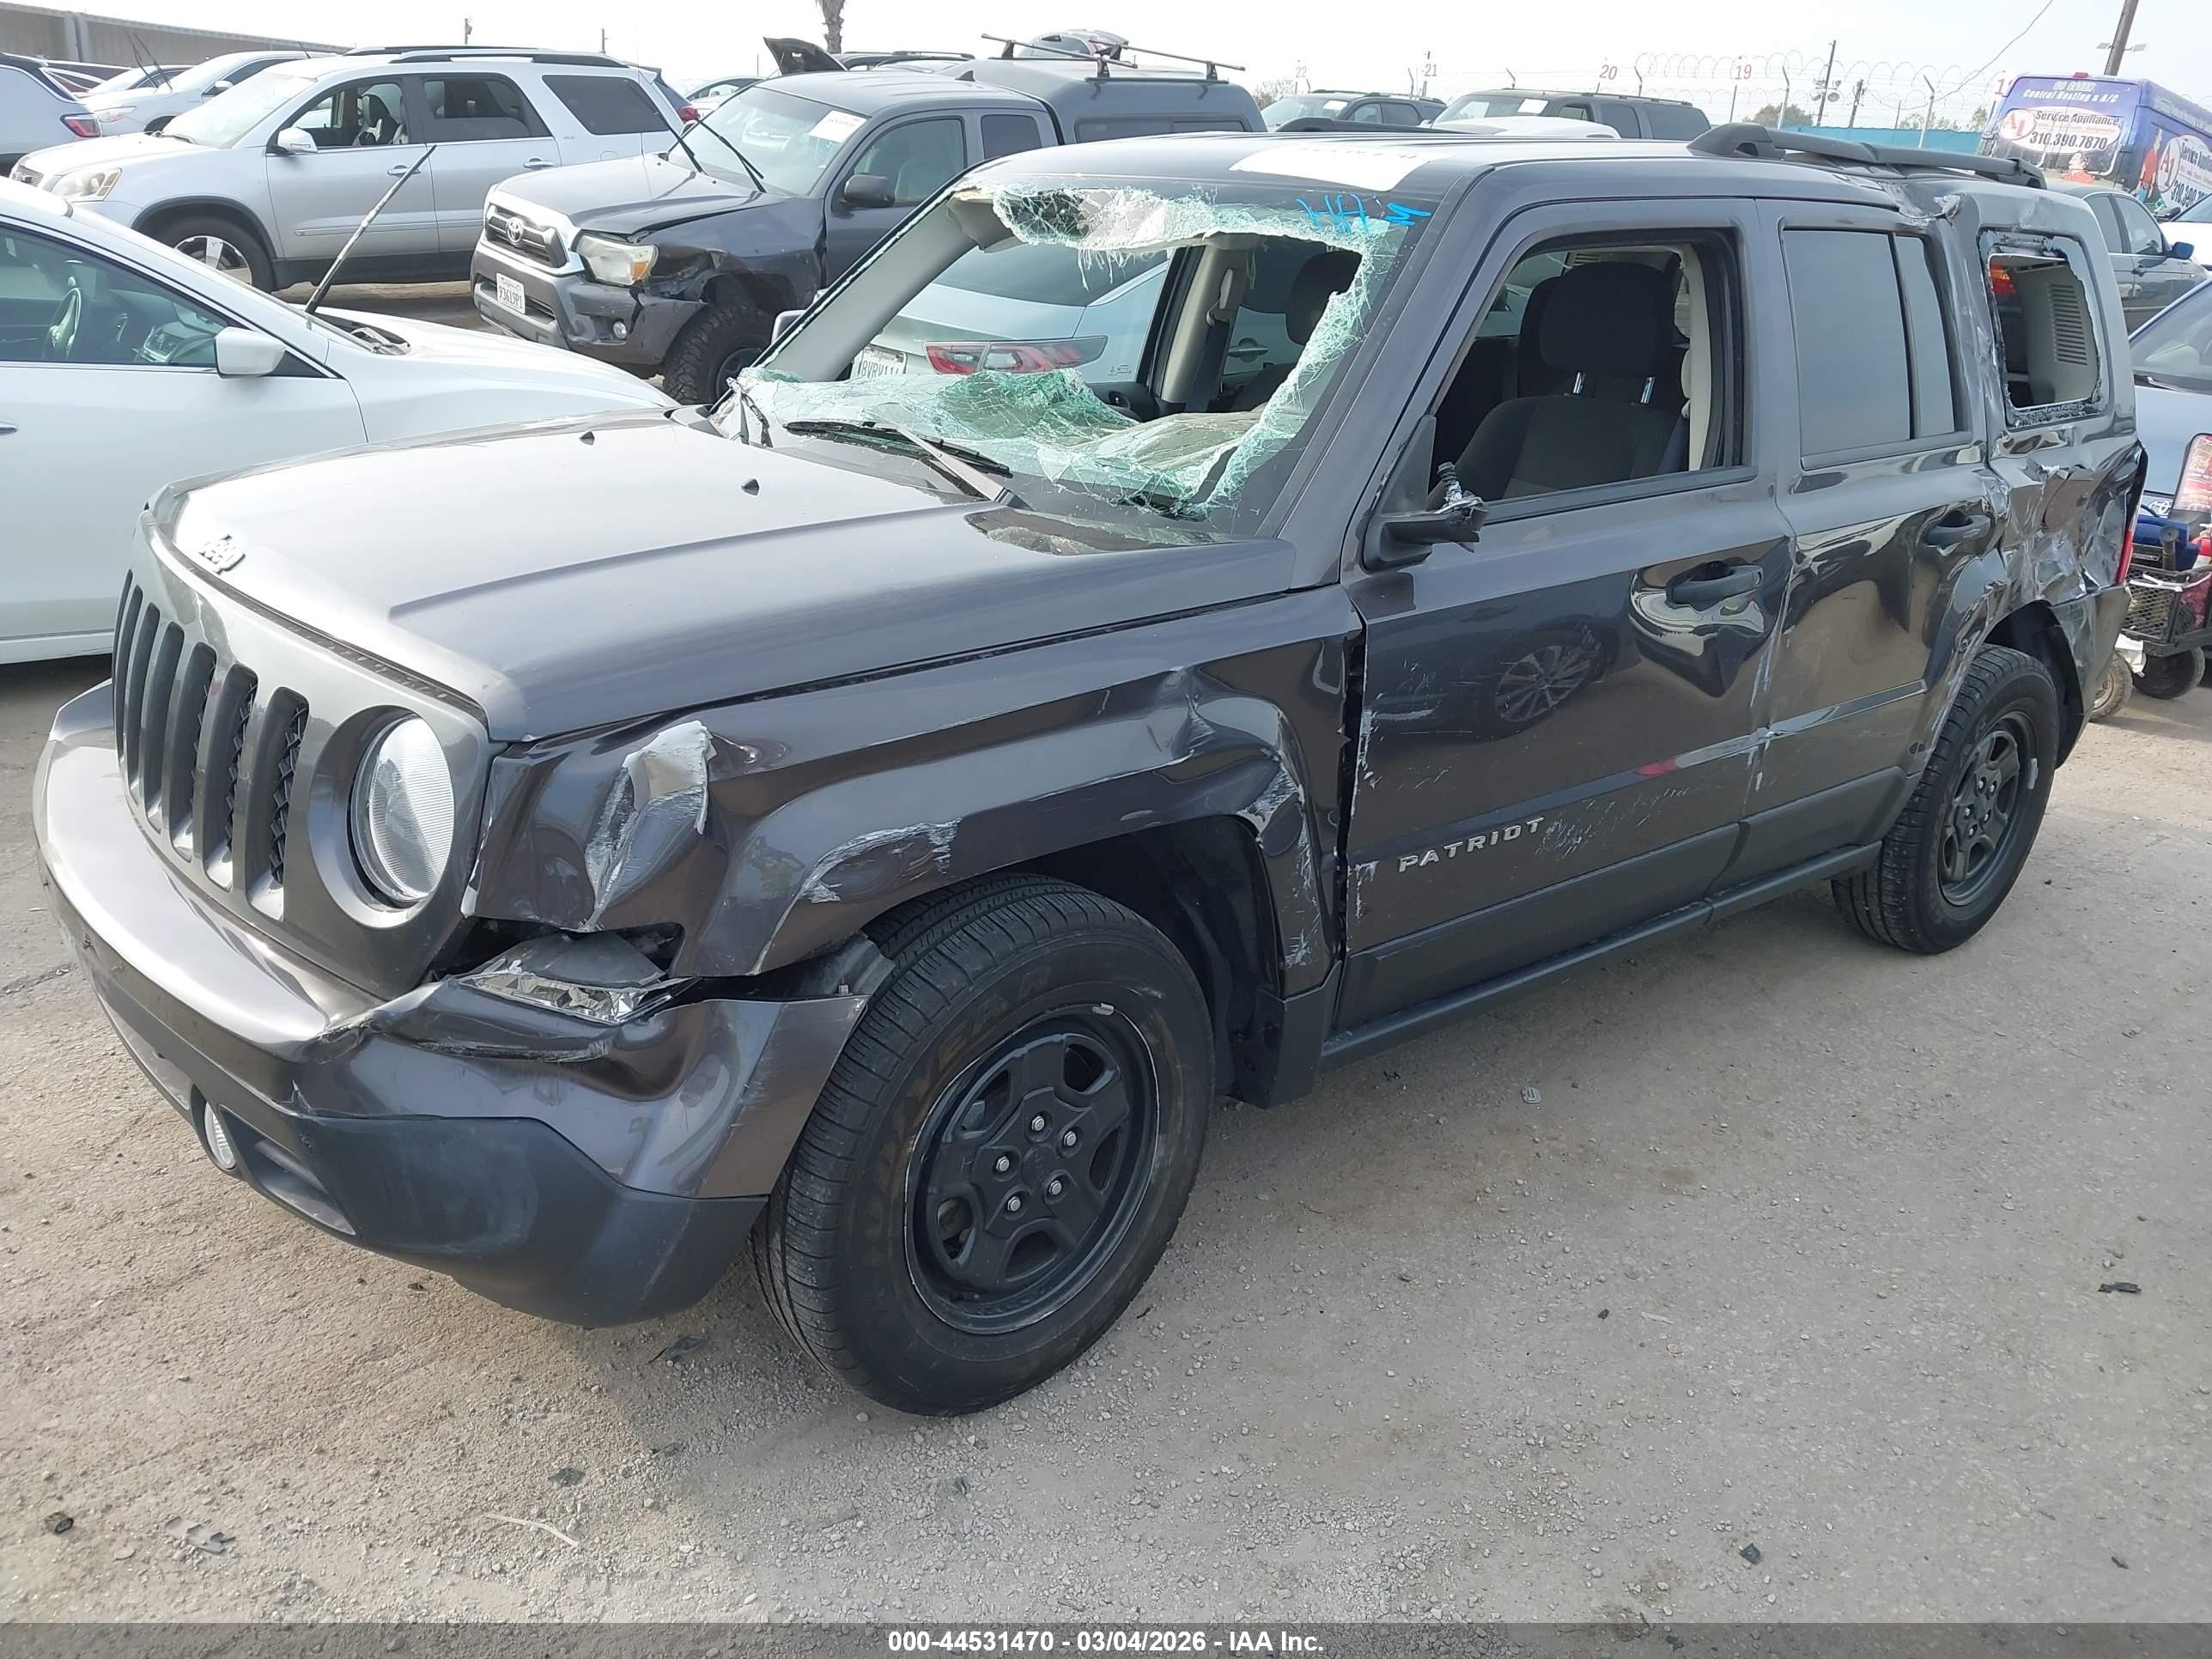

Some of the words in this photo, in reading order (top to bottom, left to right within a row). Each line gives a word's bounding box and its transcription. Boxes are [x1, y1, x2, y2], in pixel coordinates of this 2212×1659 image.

[1295, 65, 1307, 78] 22
[1424, 63, 1438, 77] 21
[1599, 64, 1618, 80] 20
[1734, 64, 1753, 80] 19
[1994, 77, 2014, 95] 1
[2100, 94, 2119, 103] A/C
[2035, 111, 2070, 123] Service
[2070, 112, 2120, 126] Appliance
[2029, 131, 2109, 150] 310.390.7870
[1397, 816, 1546, 874] PATRIOT
